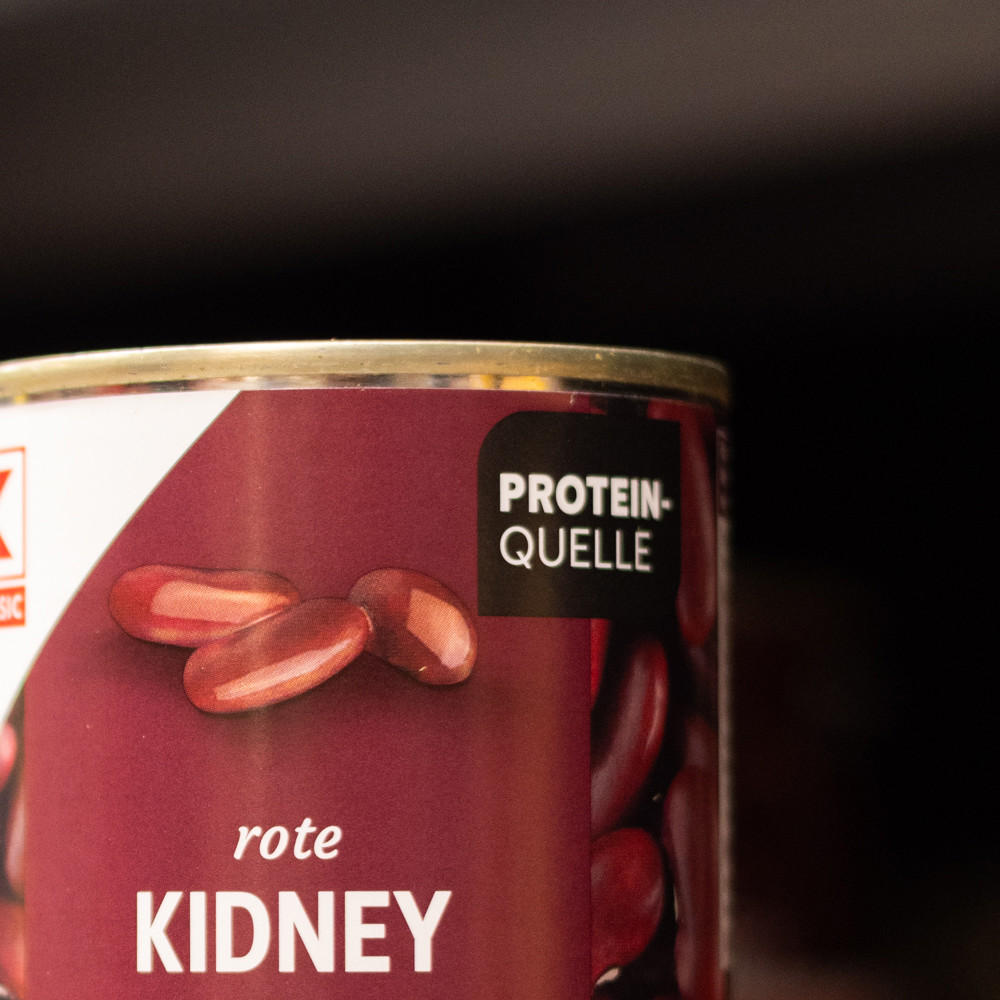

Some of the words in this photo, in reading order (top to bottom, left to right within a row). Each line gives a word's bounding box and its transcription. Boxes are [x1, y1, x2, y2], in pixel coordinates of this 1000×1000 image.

[499, 472, 671, 521] PROTEIN-
[499, 526, 653, 572] QUELLE
[233, 817, 342, 861] rote
[135, 890, 452, 973] KIDNEY
